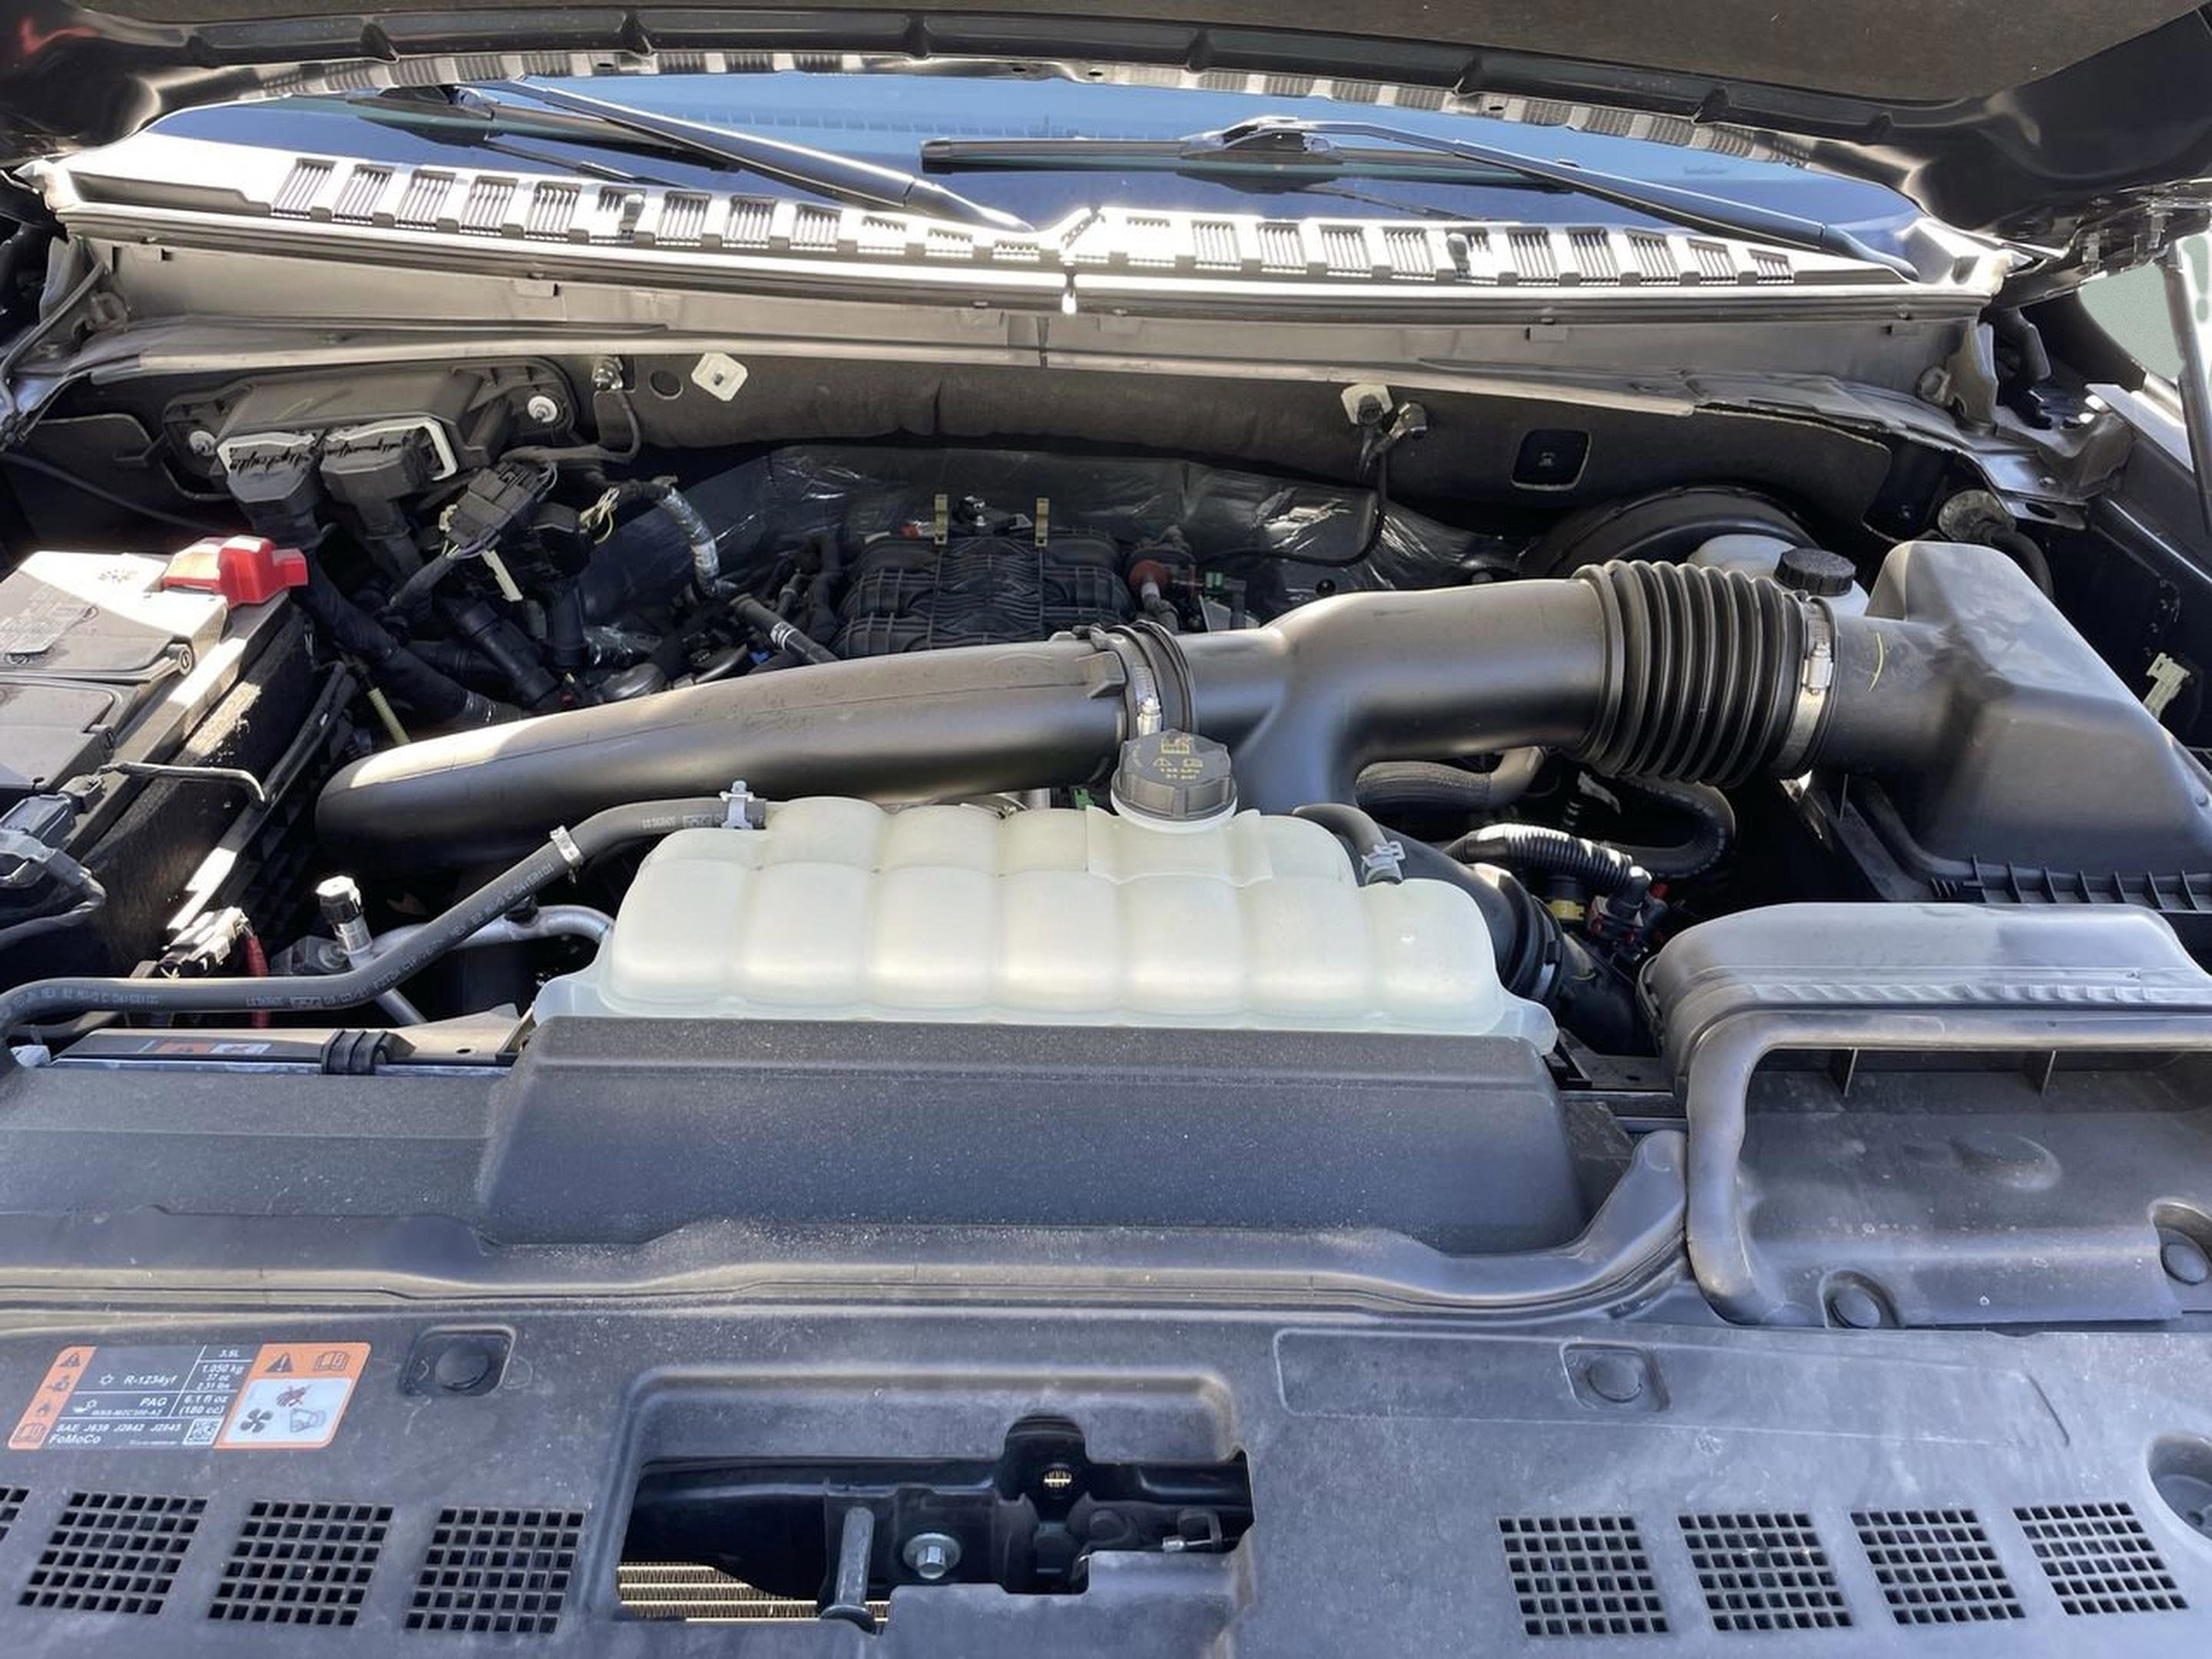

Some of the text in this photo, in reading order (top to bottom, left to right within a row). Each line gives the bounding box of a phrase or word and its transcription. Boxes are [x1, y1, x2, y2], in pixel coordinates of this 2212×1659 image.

[139, 1397, 167, 1406] PAG
[56, 1423, 80, 1432] SAE
[48, 1433, 101, 1444] FoMoCo
